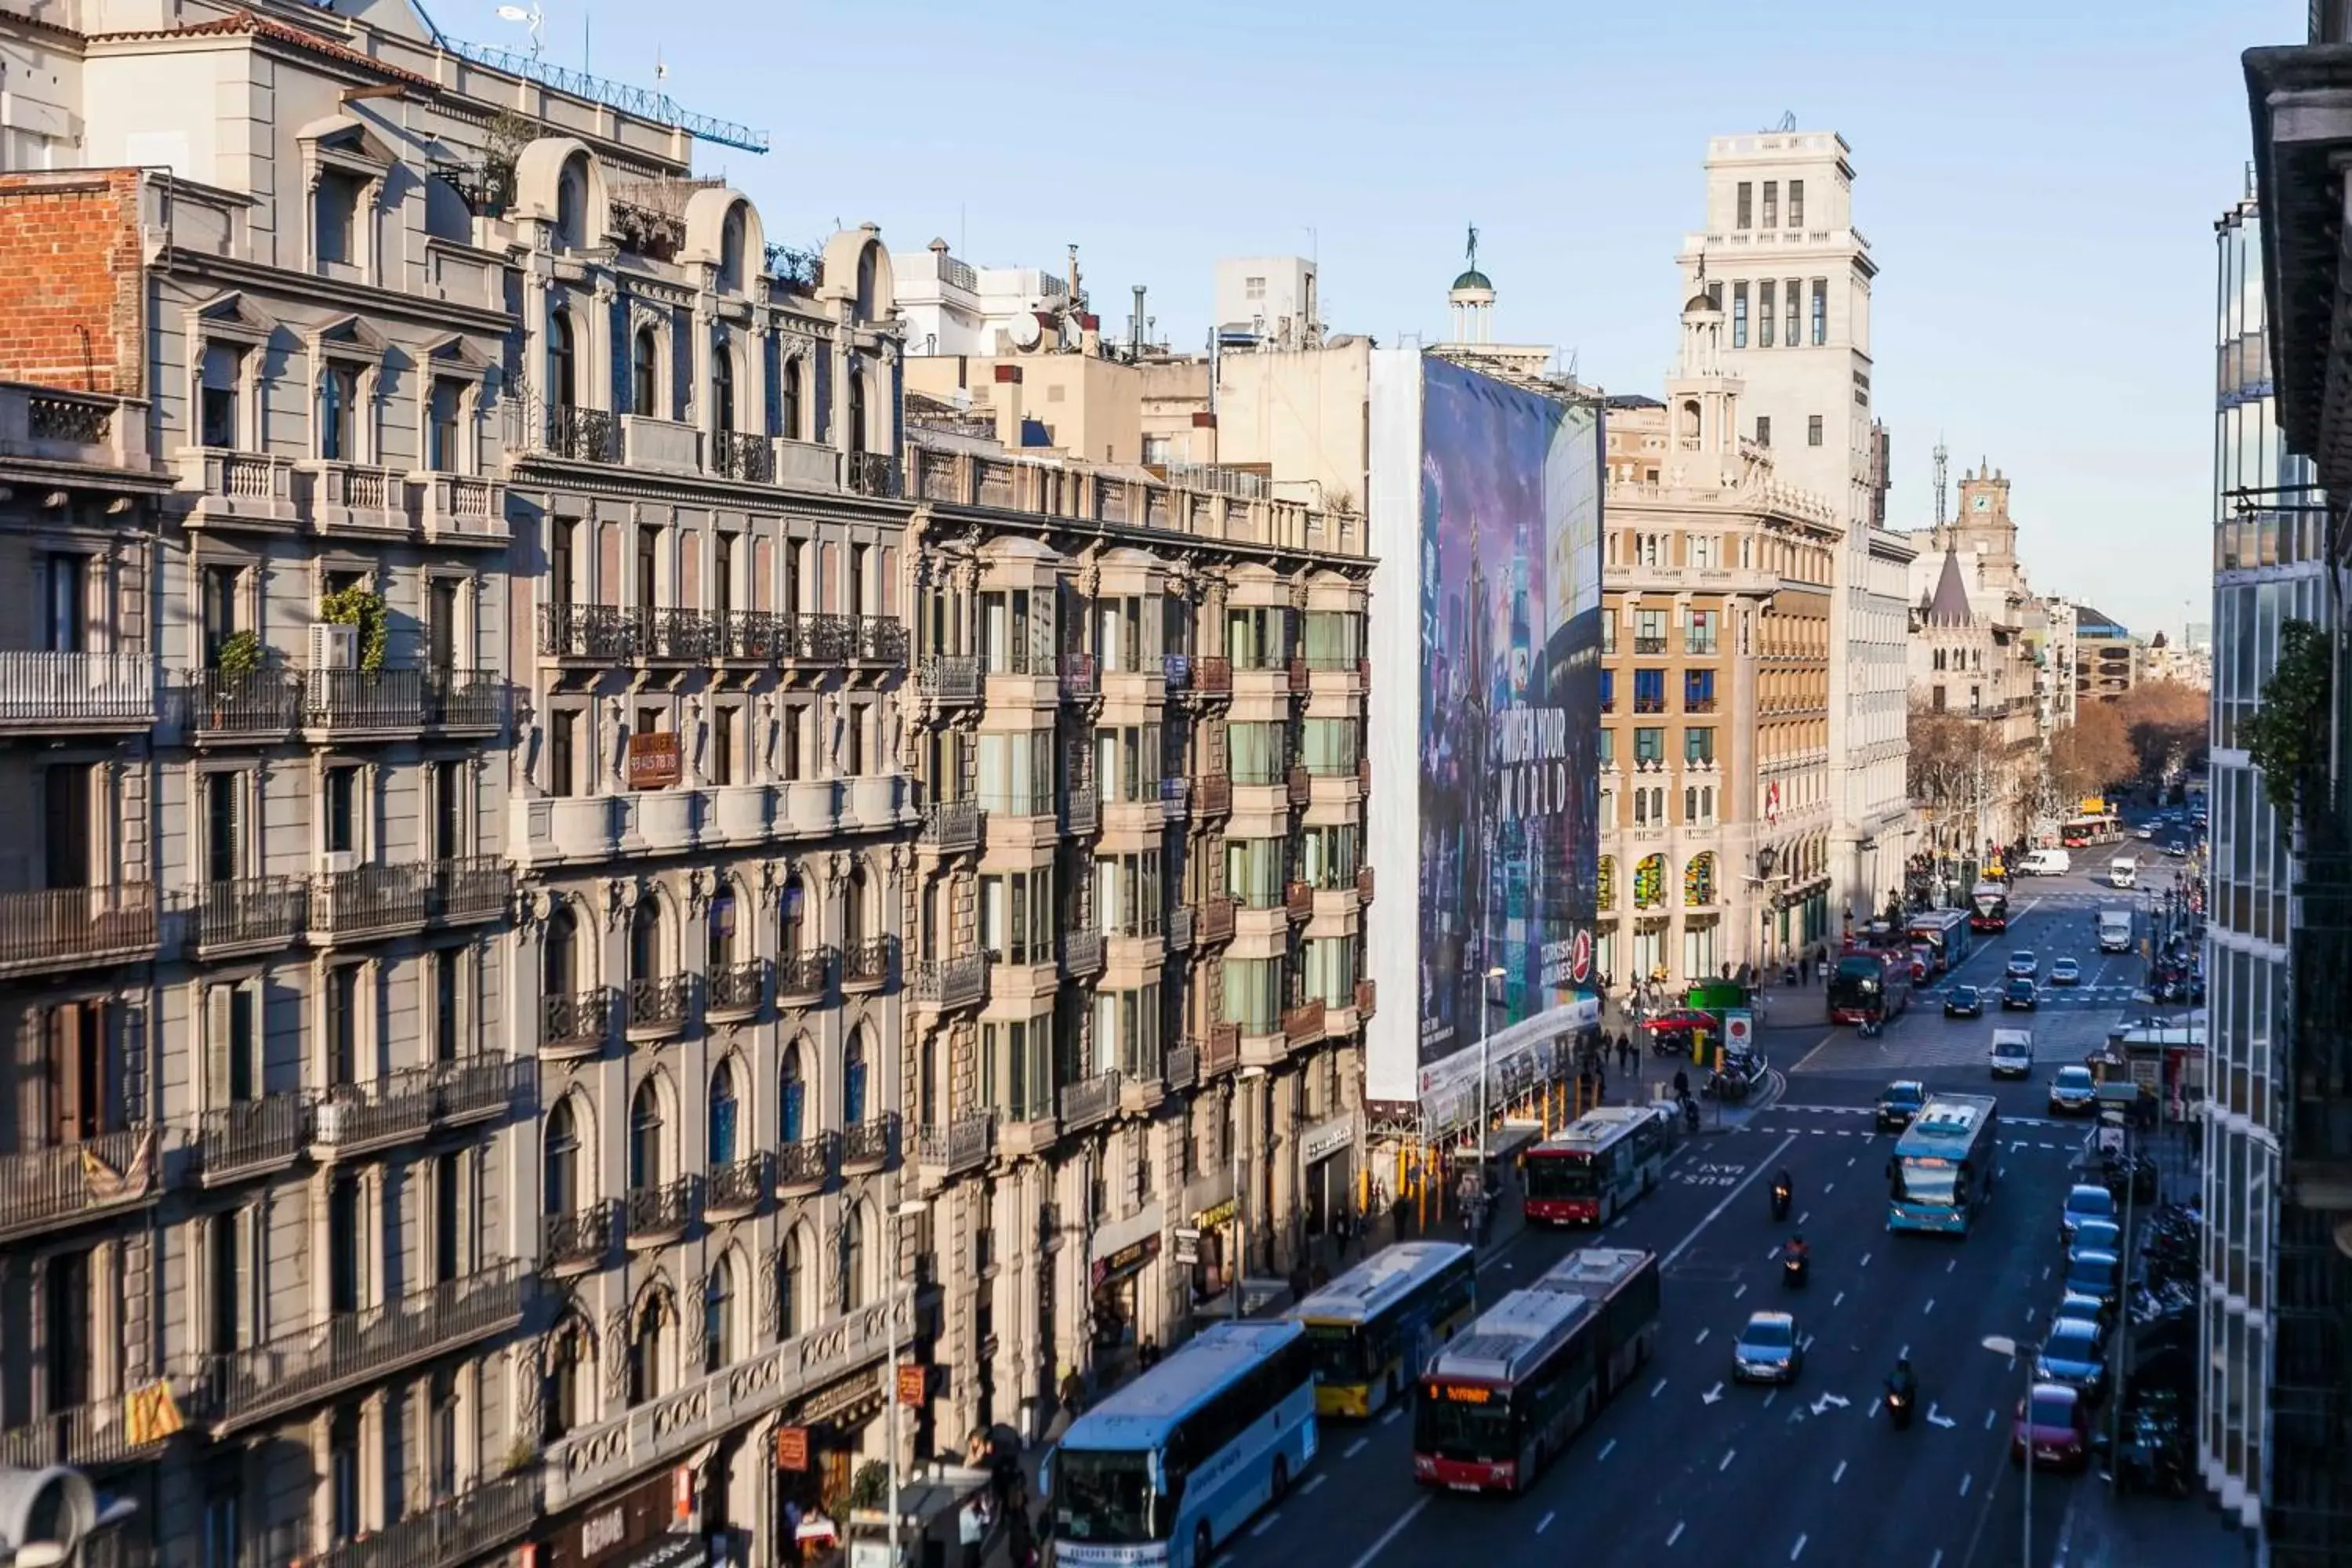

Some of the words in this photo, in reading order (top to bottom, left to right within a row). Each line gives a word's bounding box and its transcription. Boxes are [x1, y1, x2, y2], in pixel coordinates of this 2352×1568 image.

[1501, 708, 1534, 764] WIDEN
[1537, 707, 1566, 760] YOUR
[1501, 764, 1566, 822] WORLD
[1682, 1174, 1737, 1186] BUS
